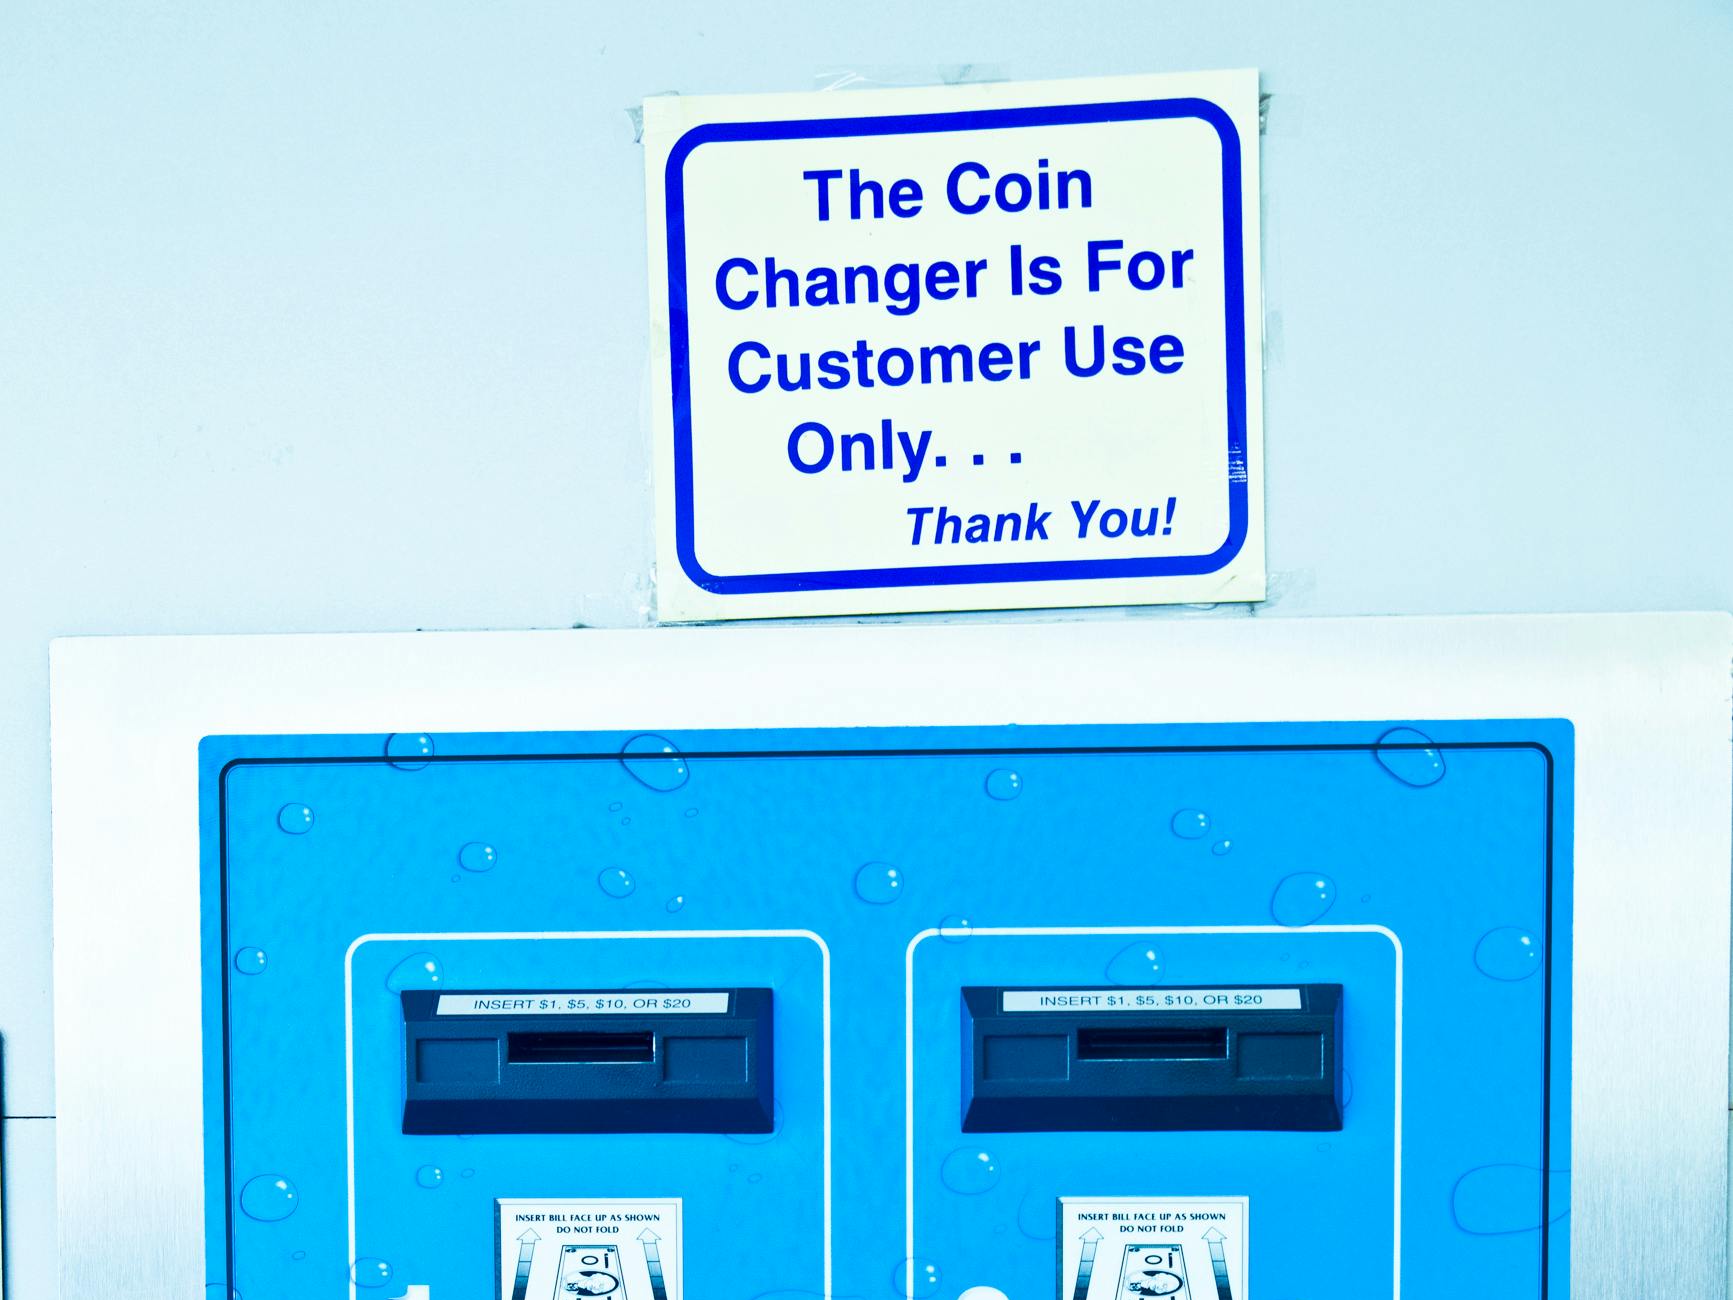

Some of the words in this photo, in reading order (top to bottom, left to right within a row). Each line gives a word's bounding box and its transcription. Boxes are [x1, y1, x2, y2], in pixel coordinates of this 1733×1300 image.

[803, 168, 923, 221] The
[946, 158, 1092, 216] Coin
[715, 256, 987, 316] Changer
[1010, 244, 1062, 297] Is
[1087, 239, 1194, 292] For
[728, 339, 1040, 394] Customer
[1064, 325, 1184, 377] Use
[906, 503, 1051, 545] Thank
[1071, 497, 1176, 539] You!
[473, 999, 535, 1010] INSERT
[539, 999, 561, 1010] $1,
[567, 999, 589, 1010] $5,
[595, 999, 627, 1010] $10,
[633, 999, 658, 1009] OR
[662, 998, 691, 1009] $20
[1040, 996, 1101, 1006] INSERT
[1107, 995, 1130, 1006] $1,
[1136, 995, 1159, 1006] $5,
[1165, 995, 1198, 1006] $10,
[1203, 995, 1229, 1005] OR
[1234, 994, 1263, 1005] $20
[515, 1214, 545, 1222] INSERT
[549, 1214, 567, 1222] BILL
[570, 1214, 591, 1222] FACE
[595, 1214, 607, 1222] UP
[610, 1214, 622, 1222] AS
[625, 1214, 660, 1222] SHOWN
[1078, 1213, 1109, 1221] INSERT
[1112, 1213, 1130, 1221] BILL
[1134, 1213, 1156, 1221] FACE
[1160, 1213, 1172, 1221] UP
[1174, 1213, 1187, 1221] AS
[1190, 1213, 1226, 1221] SHOWN
[556, 1226, 571, 1234] DO
[573, 1226, 592, 1234] NOT
[596, 1226, 619, 1234] FOLD
[1120, 1225, 1134, 1233] DO
[1137, 1225, 1156, 1233] NOT
[1160, 1225, 1184, 1233] FOLD
